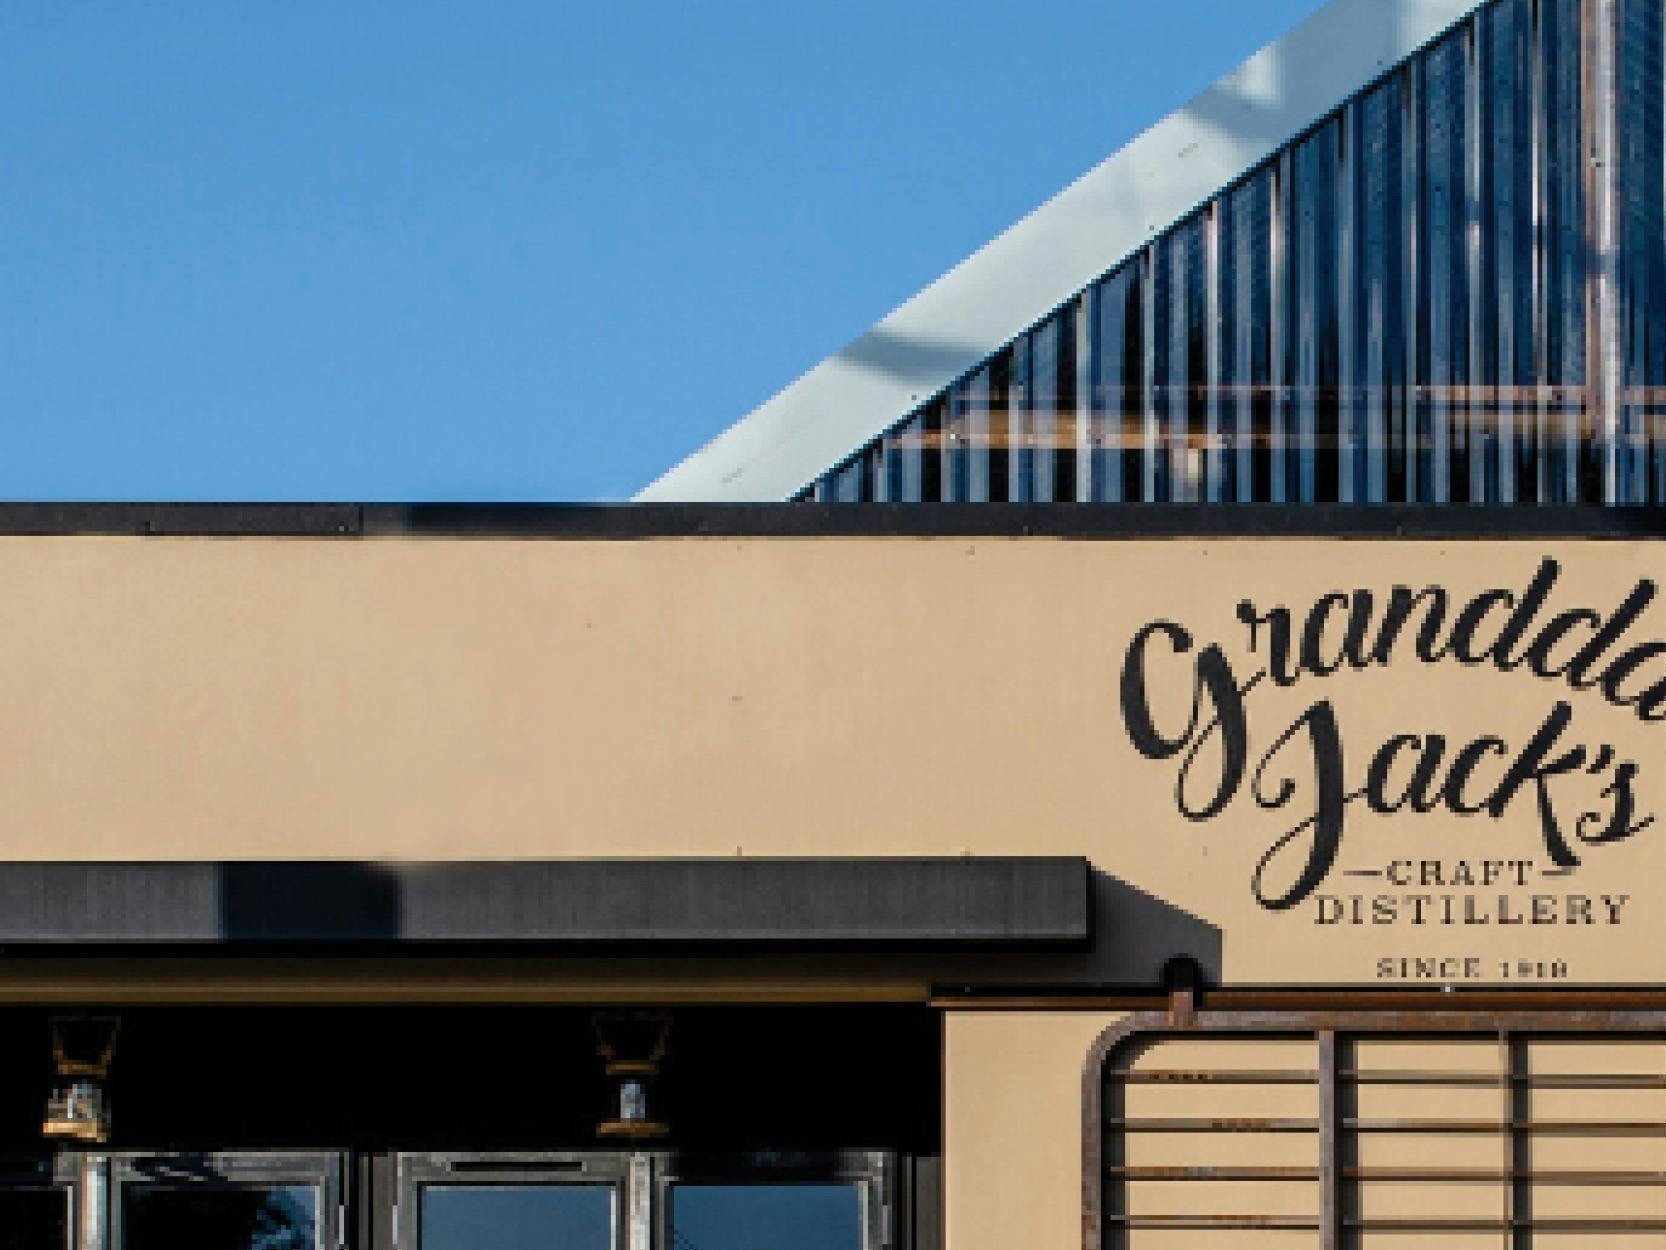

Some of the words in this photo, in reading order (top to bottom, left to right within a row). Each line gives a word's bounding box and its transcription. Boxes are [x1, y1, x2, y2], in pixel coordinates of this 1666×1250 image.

[1252, 701, 1655, 911] Jack's
[1386, 860, 1534, 886] CRAFT
[1314, 894, 1631, 925] DISTILLERY
[1376, 957, 1481, 979] SINCE
